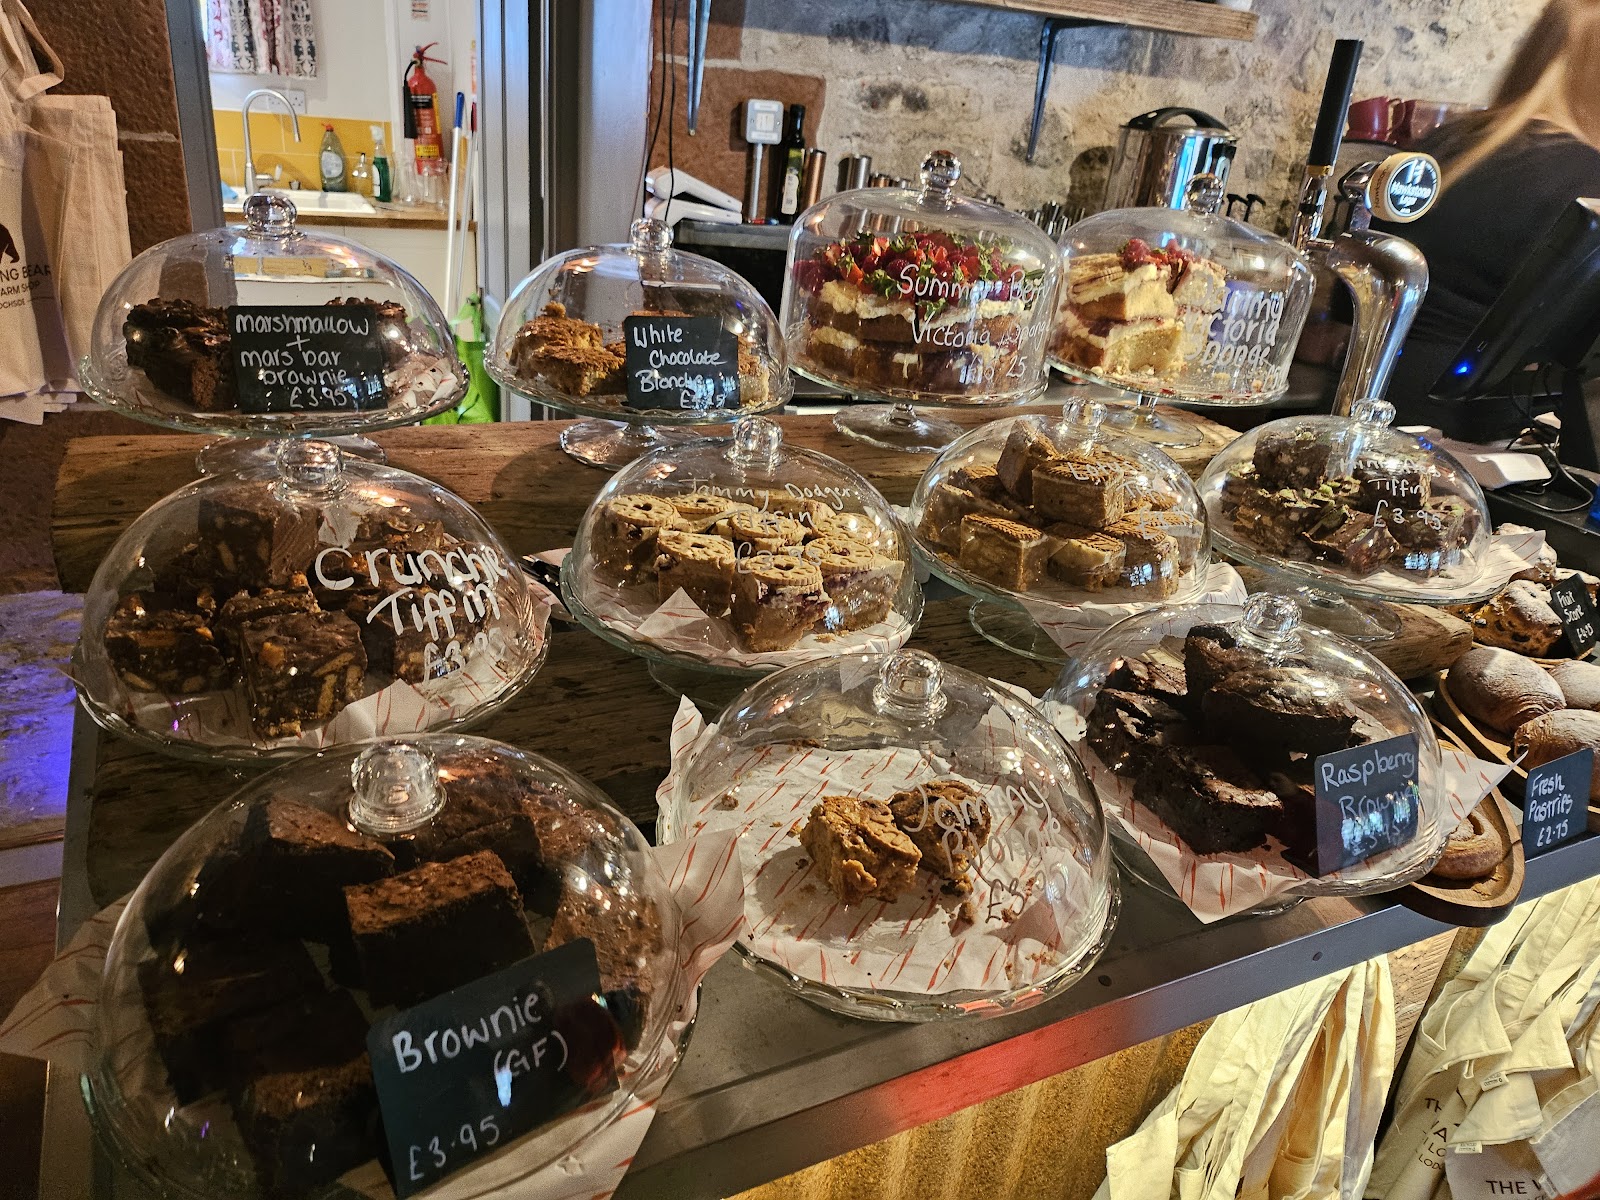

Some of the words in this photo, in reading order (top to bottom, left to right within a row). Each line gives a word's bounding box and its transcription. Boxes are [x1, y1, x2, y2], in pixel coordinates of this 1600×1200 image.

[633, 323, 683, 349] White
[911, 311, 991, 348] Victoria
[302, 350, 341, 366] bar
[649, 348, 728, 369] Chocolate
[290, 386, 348, 409] £3.95
[678, 477, 770, 514] Jammy
[1367, 477, 1425, 498] Tiffin
[1374, 499, 1442, 531] £3.95
[314, 545, 508, 590] Crunchie
[366, 583, 500, 641] Tiffin
[1321, 749, 1415, 792] Raspberry
[1531, 773, 1565, 798] Fresh
[392, 993, 542, 1074] Brownie
[410, 1115, 500, 1181] £3.95
[1486, 1180, 1528, 1195] THE
